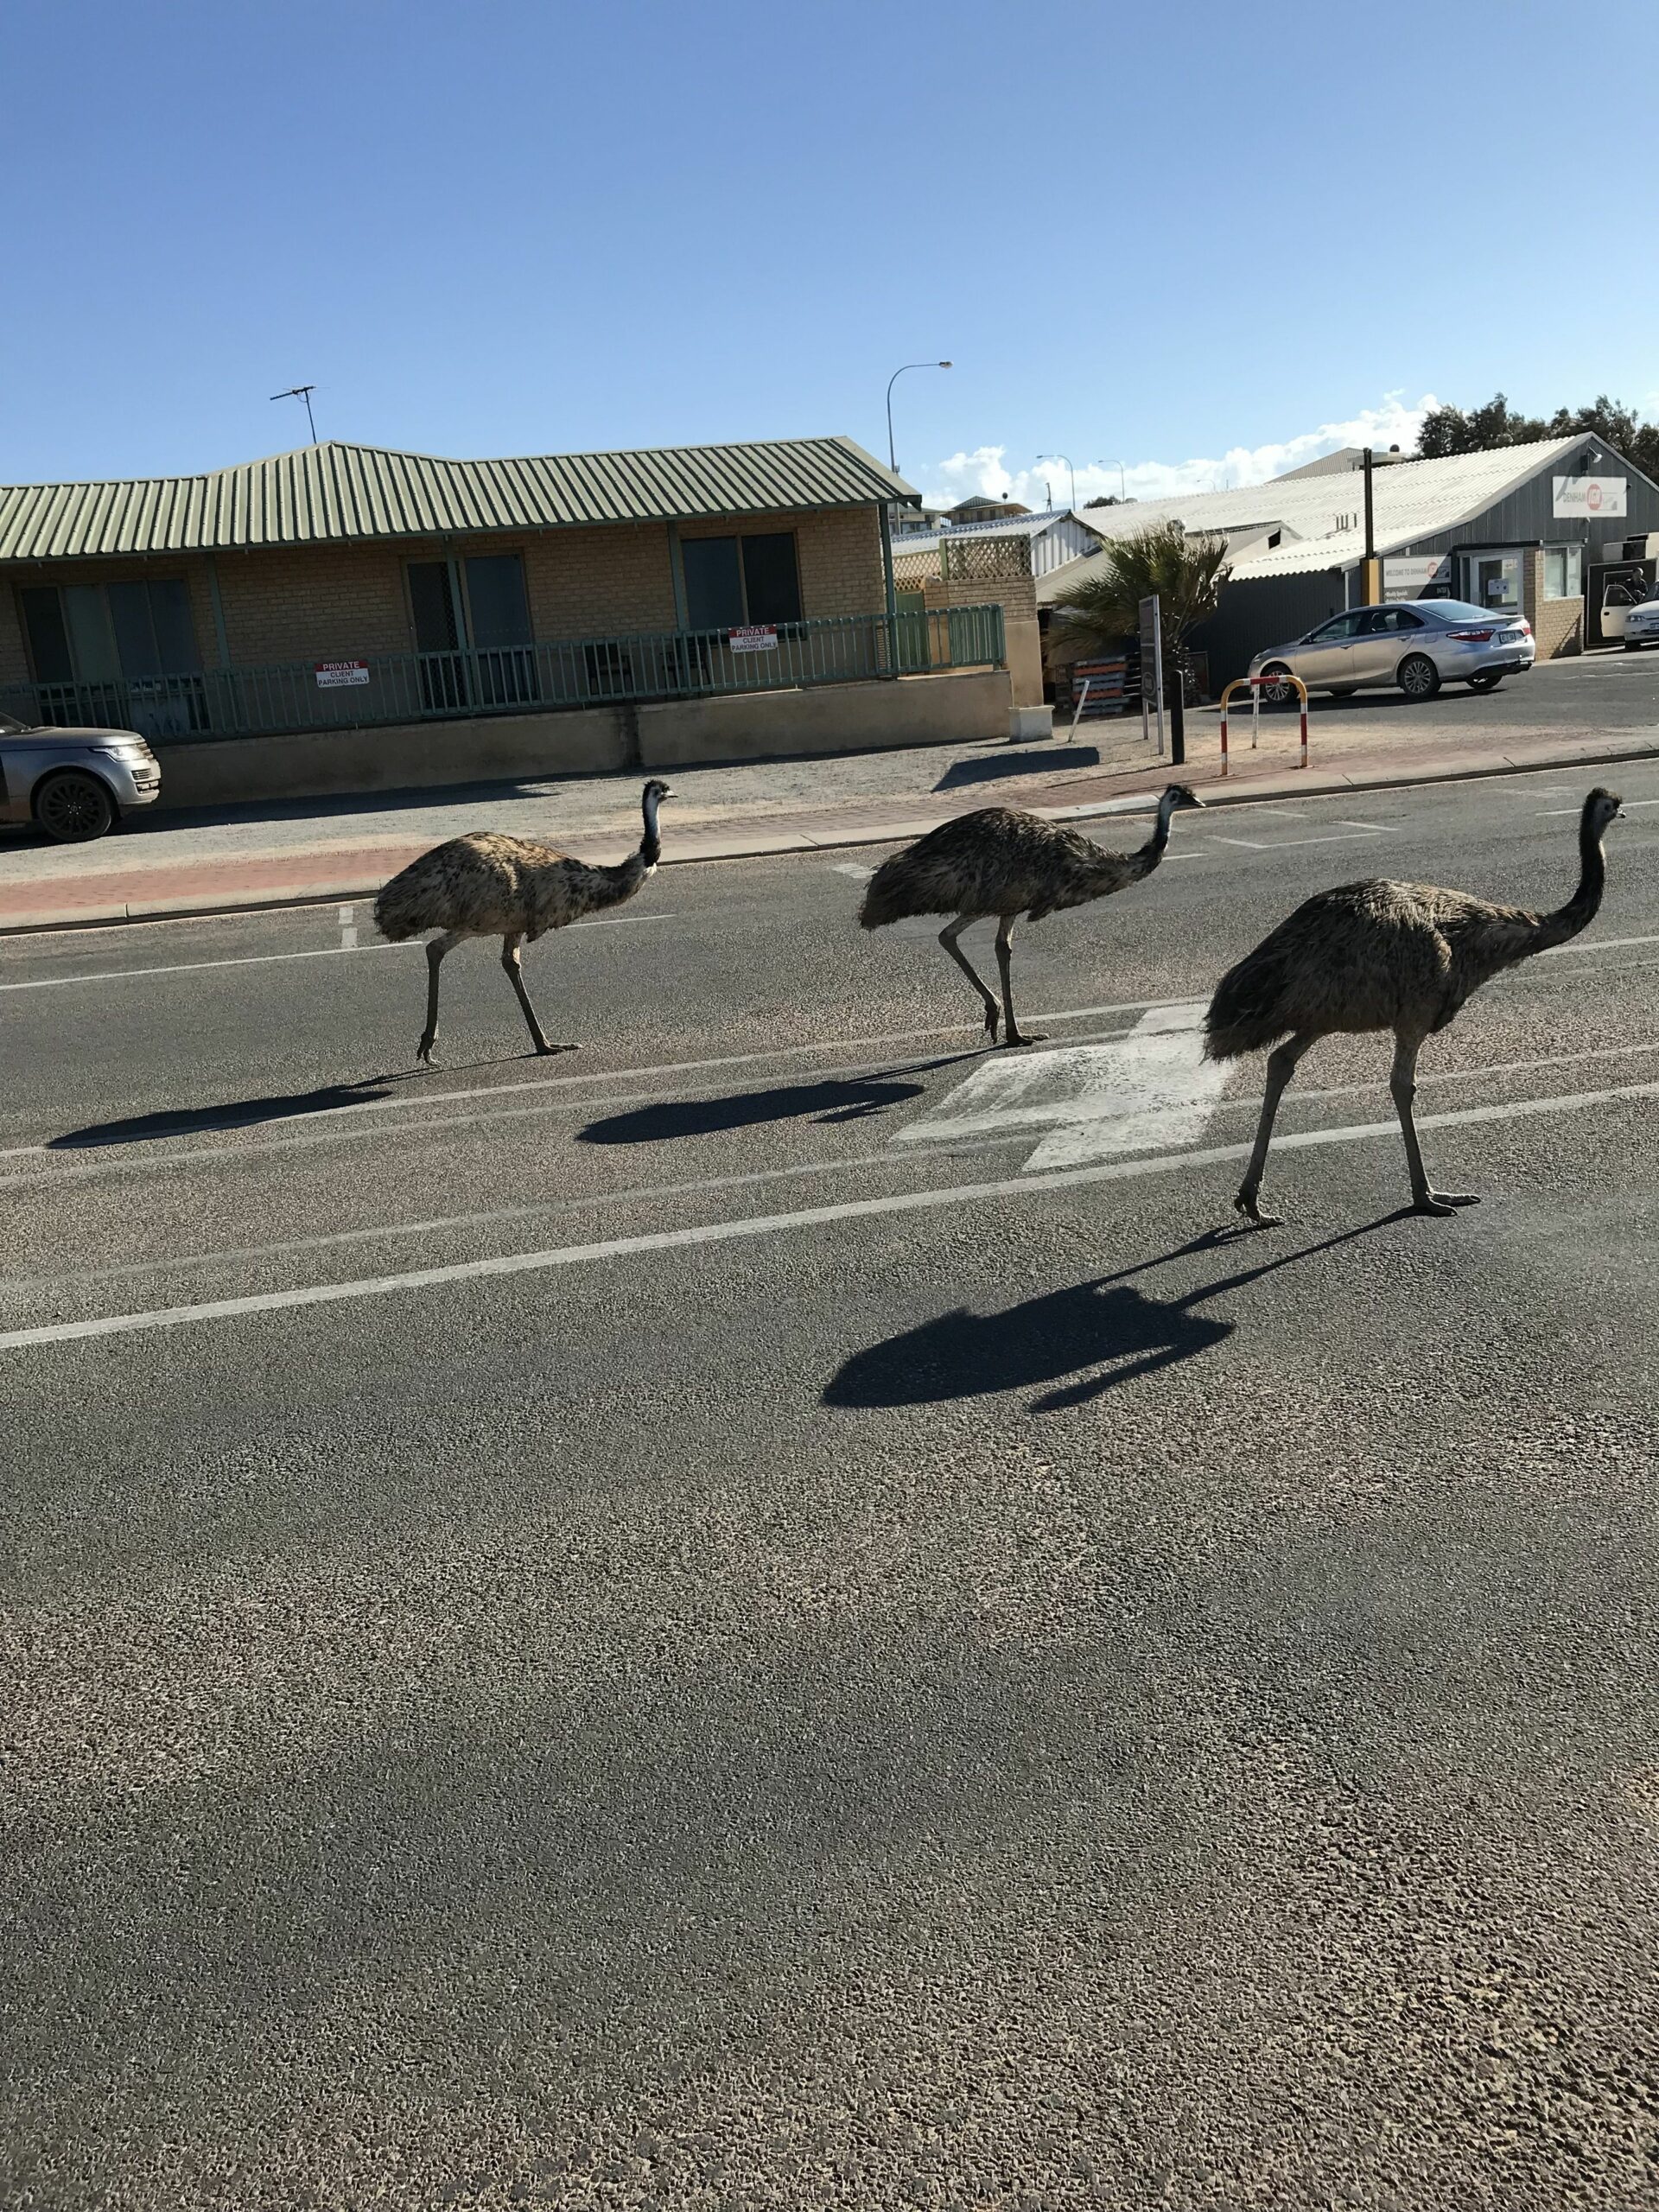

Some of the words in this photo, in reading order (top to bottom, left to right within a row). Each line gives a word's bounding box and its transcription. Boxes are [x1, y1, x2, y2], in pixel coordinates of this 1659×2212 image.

[1563, 492, 1586, 503] DENHAM
[736, 627, 770, 637] PRIVATE
[322, 661, 360, 671] PRIVATE
[318, 677, 349, 686] PARKING
